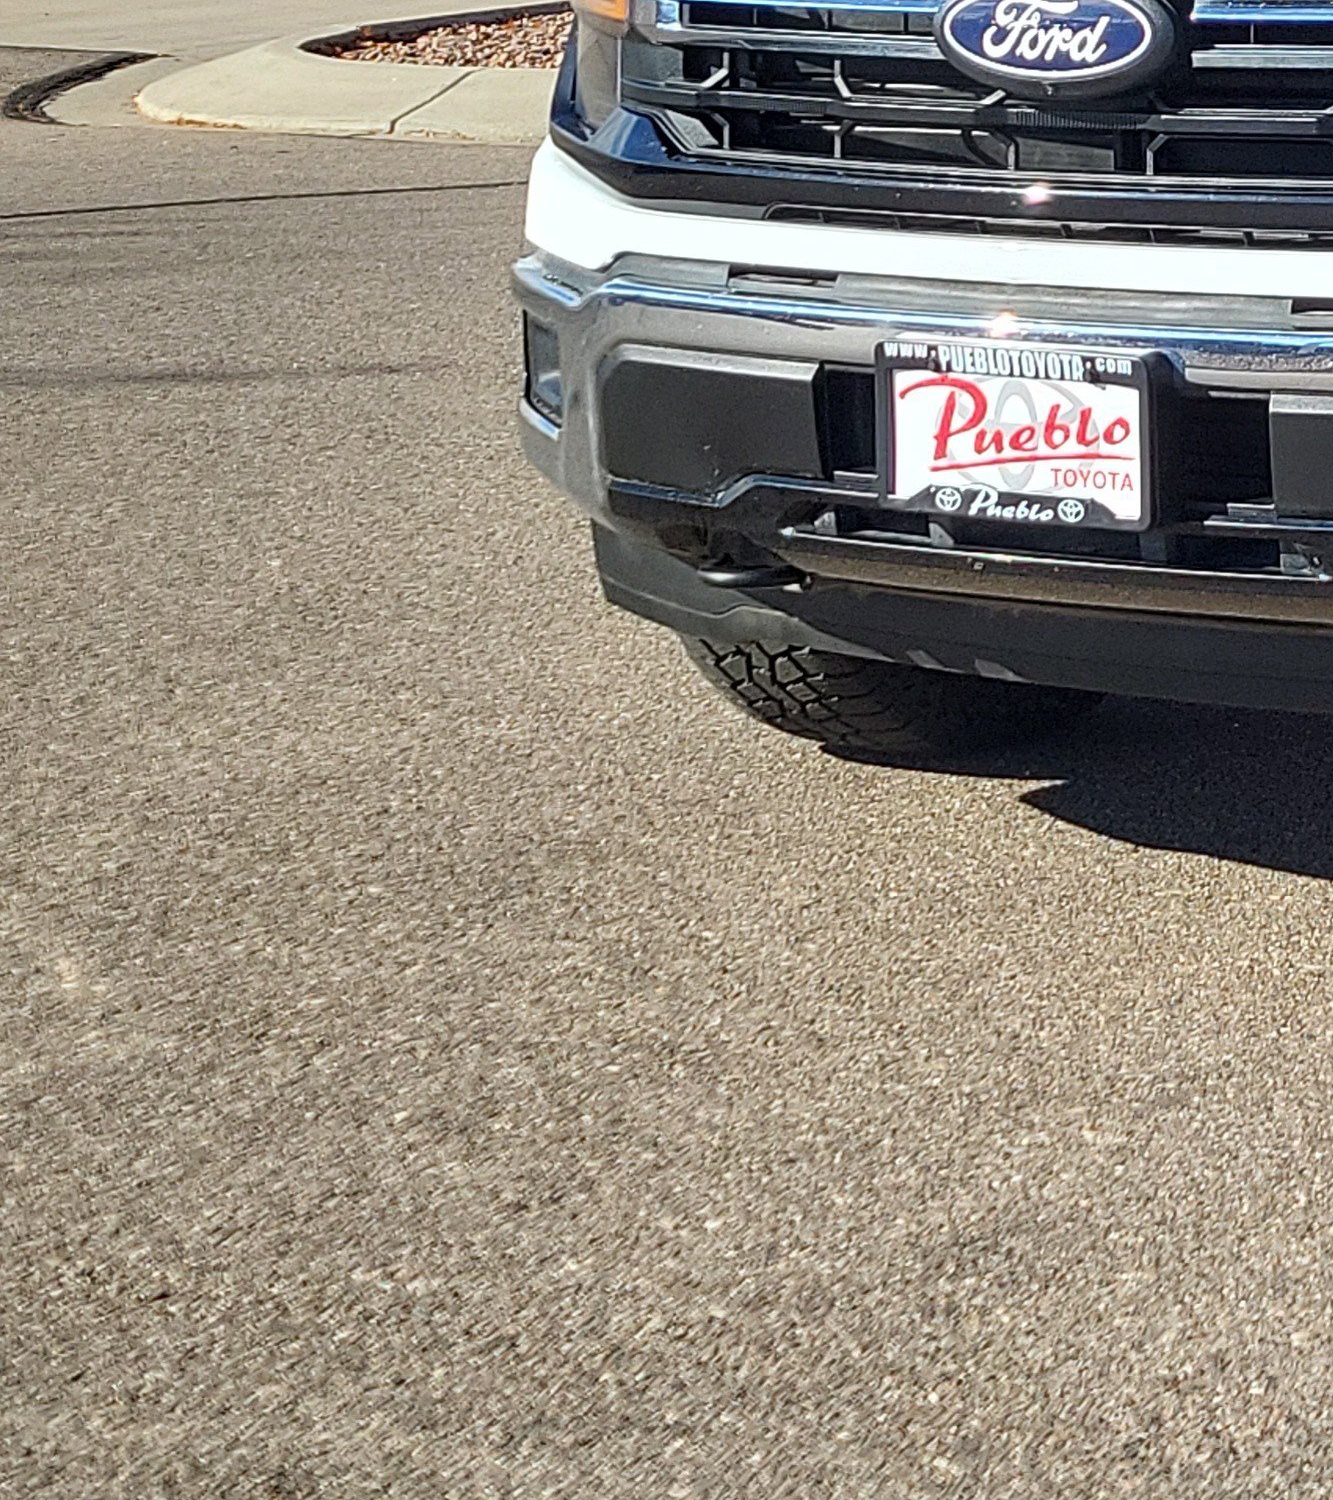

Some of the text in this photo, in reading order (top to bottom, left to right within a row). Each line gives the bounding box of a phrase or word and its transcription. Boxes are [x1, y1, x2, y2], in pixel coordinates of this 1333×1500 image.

[899, 375, 1131, 460] Pueblo
[1050, 467, 1134, 491] TOYOTA
[967, 484, 1055, 522] Pueblo
